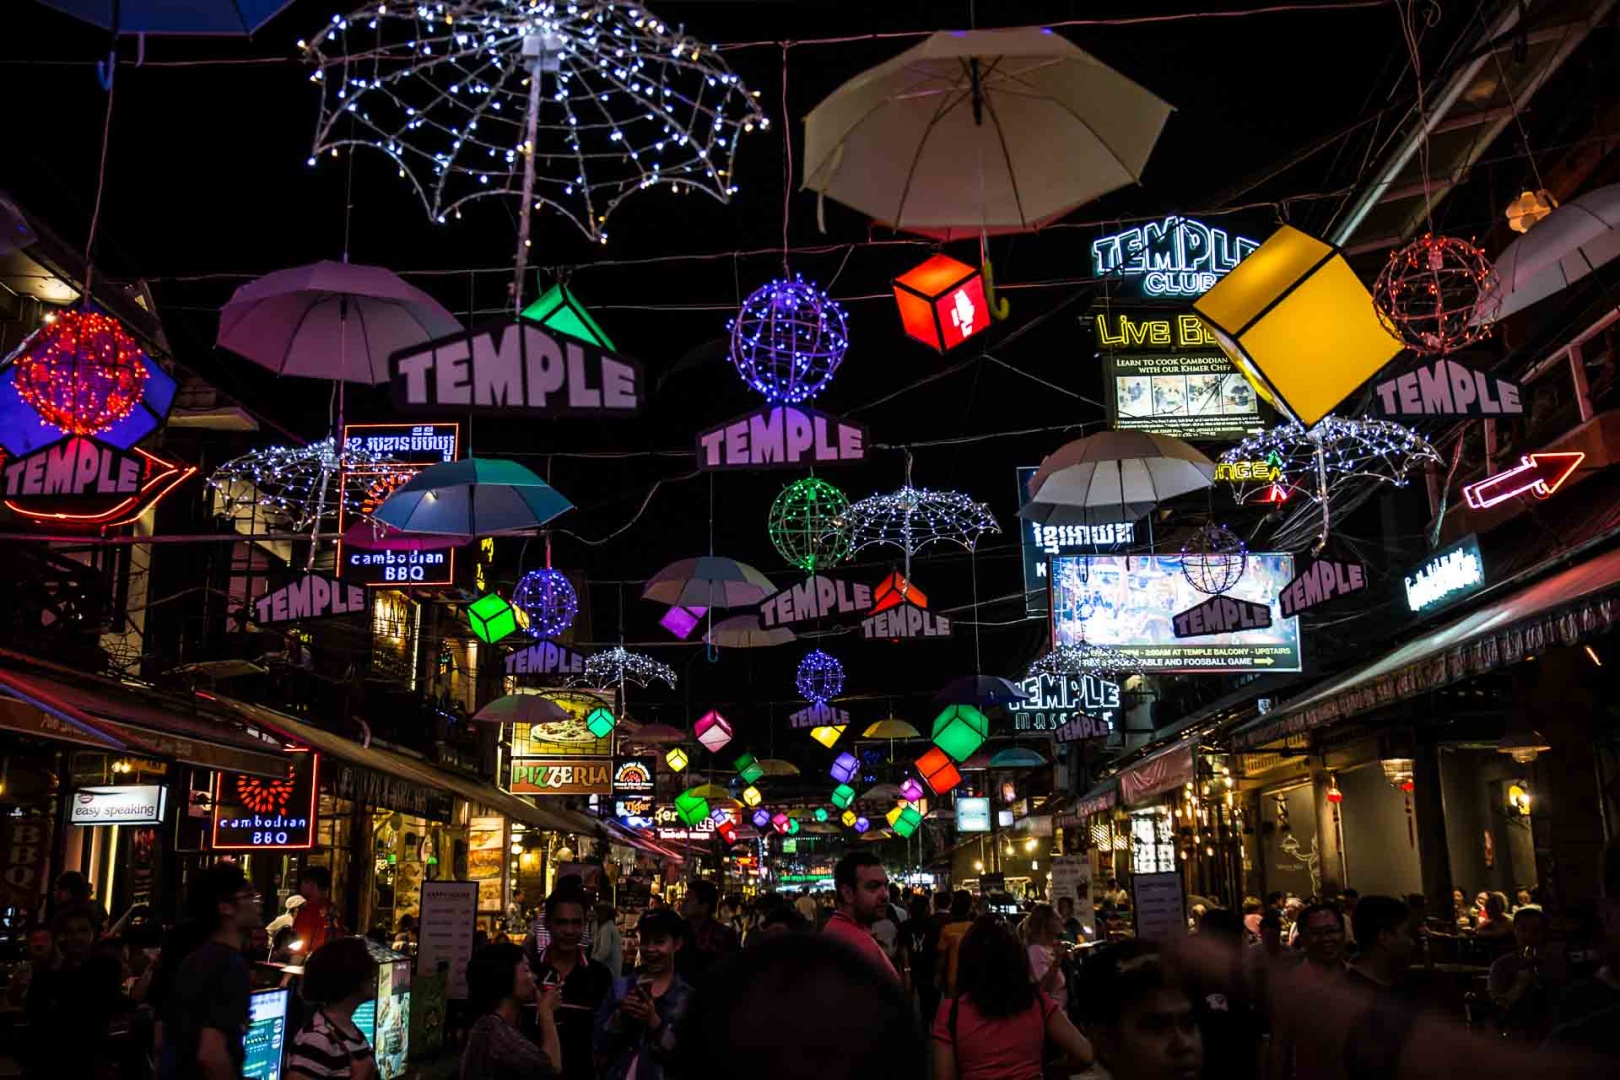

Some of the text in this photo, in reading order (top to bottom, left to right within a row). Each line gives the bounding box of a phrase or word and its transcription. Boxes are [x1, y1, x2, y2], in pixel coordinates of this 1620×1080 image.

[1145, 272, 1217, 295] CLUB
[397, 324, 638, 410] TEMPLE
[1377, 359, 1523, 415] TEMPLE
[700, 404, 864, 466] TEMPLE
[4, 438, 140, 496] TEMPLE
[350, 550, 444, 565] cambodian
[385, 566, 424, 580] BBQ
[256, 574, 365, 623] TEMPLE
[760, 574, 871, 627] TEMPLE
[1281, 560, 1365, 616] TEMPLE
[861, 602, 950, 639] TEMPLE
[1174, 598, 1271, 636] TEMPLE
[504, 640, 584, 674] TEMPLE
[790, 702, 850, 728] TEMPLE
[1056, 716, 1107, 742] TEMPLE
[513, 765, 609, 787] PIZZERIA
[75, 803, 155, 818] easy speaking
[220, 814, 306, 828] cambodian
